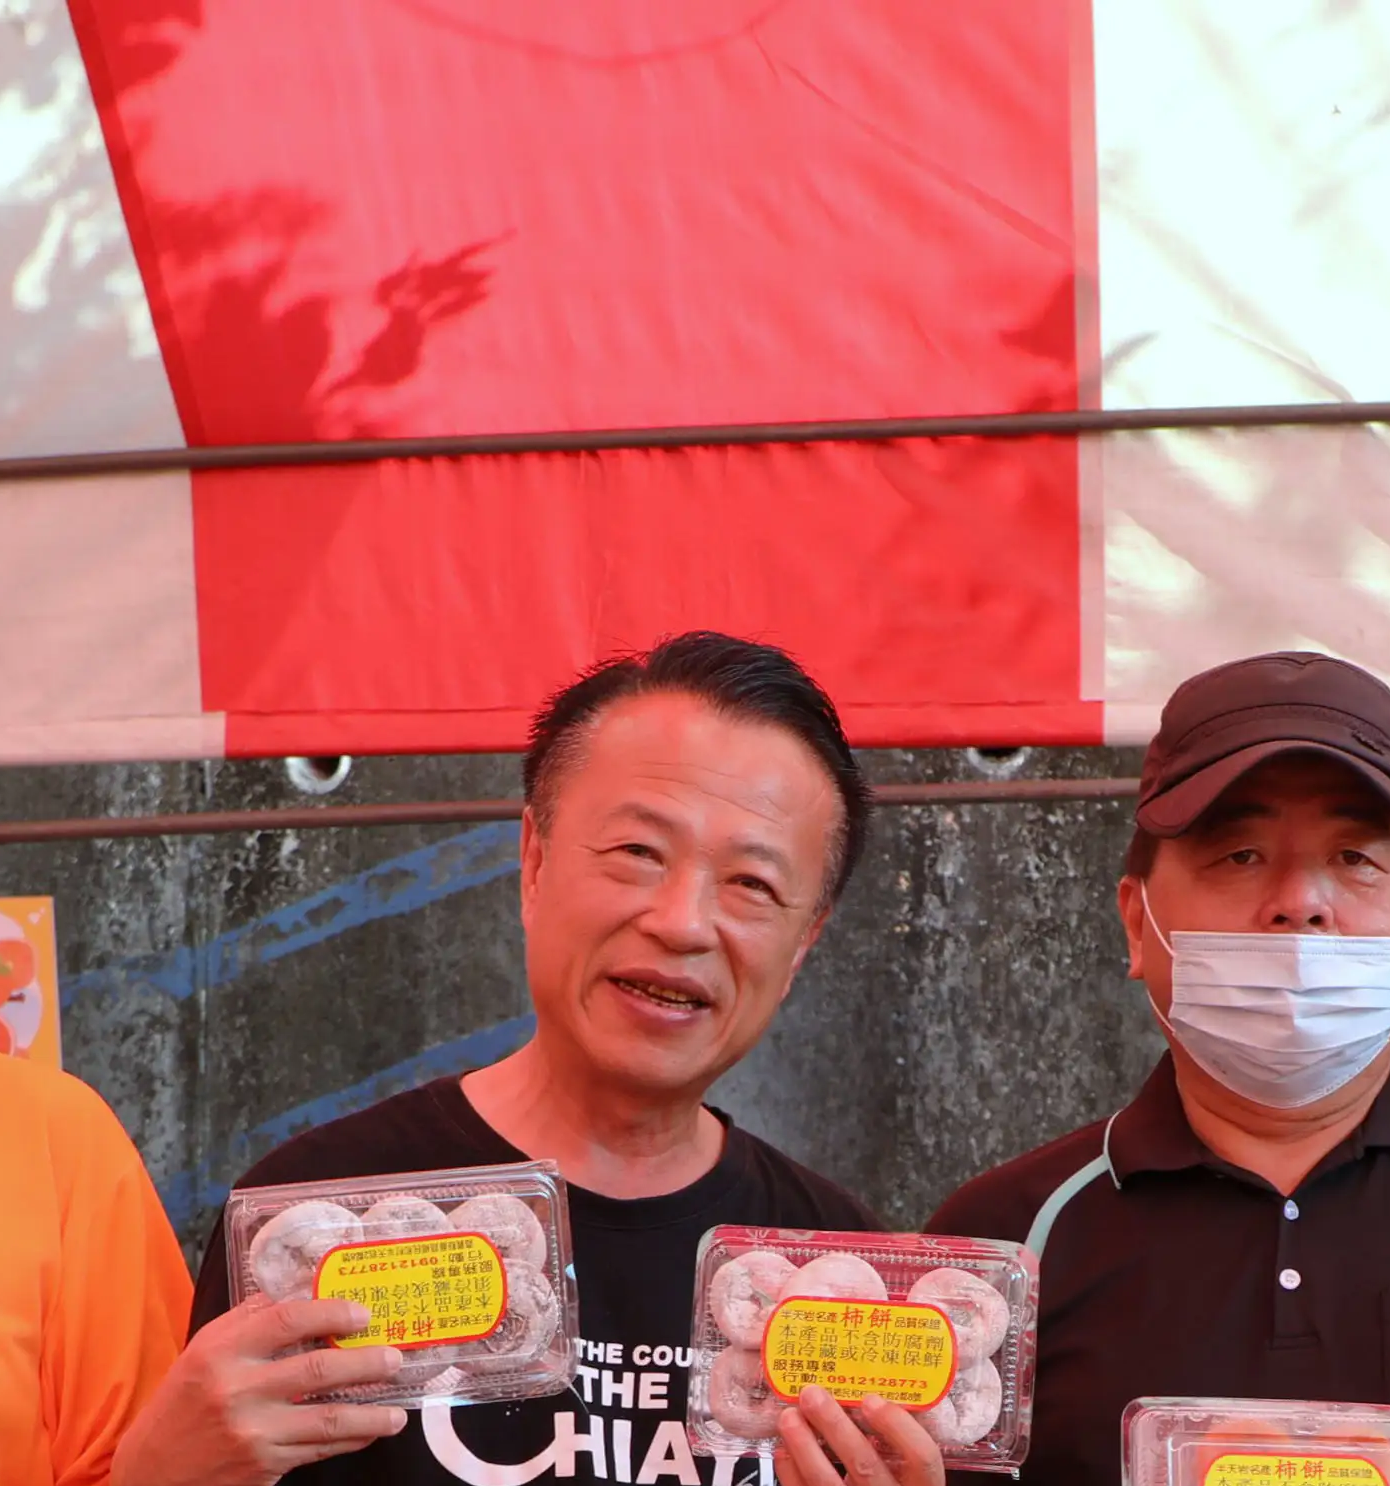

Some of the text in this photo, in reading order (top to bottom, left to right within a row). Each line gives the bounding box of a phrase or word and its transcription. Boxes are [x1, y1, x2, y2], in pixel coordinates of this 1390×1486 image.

[339, 1257, 438, 1275] 0912128773
[431, 1260, 493, 1278] 服務專線
[371, 1294, 492, 1318] 本產品不含防
[780, 1306, 941, 1330] 半天岩名產 柿餅 品質保證
[385, 1316, 436, 1341] 柿餅
[779, 1325, 944, 1352] 本產品不含防腐劑
[574, 1337, 695, 1367] THE COU
[777, 1340, 943, 1368] 須冷藏或冷凍保鮮
[773, 1359, 836, 1372] 服務專線
[576, 1365, 670, 1409] THE
[827, 1375, 928, 1389] 0912128773
[1275, 1459, 1324, 1480] 柿餅
